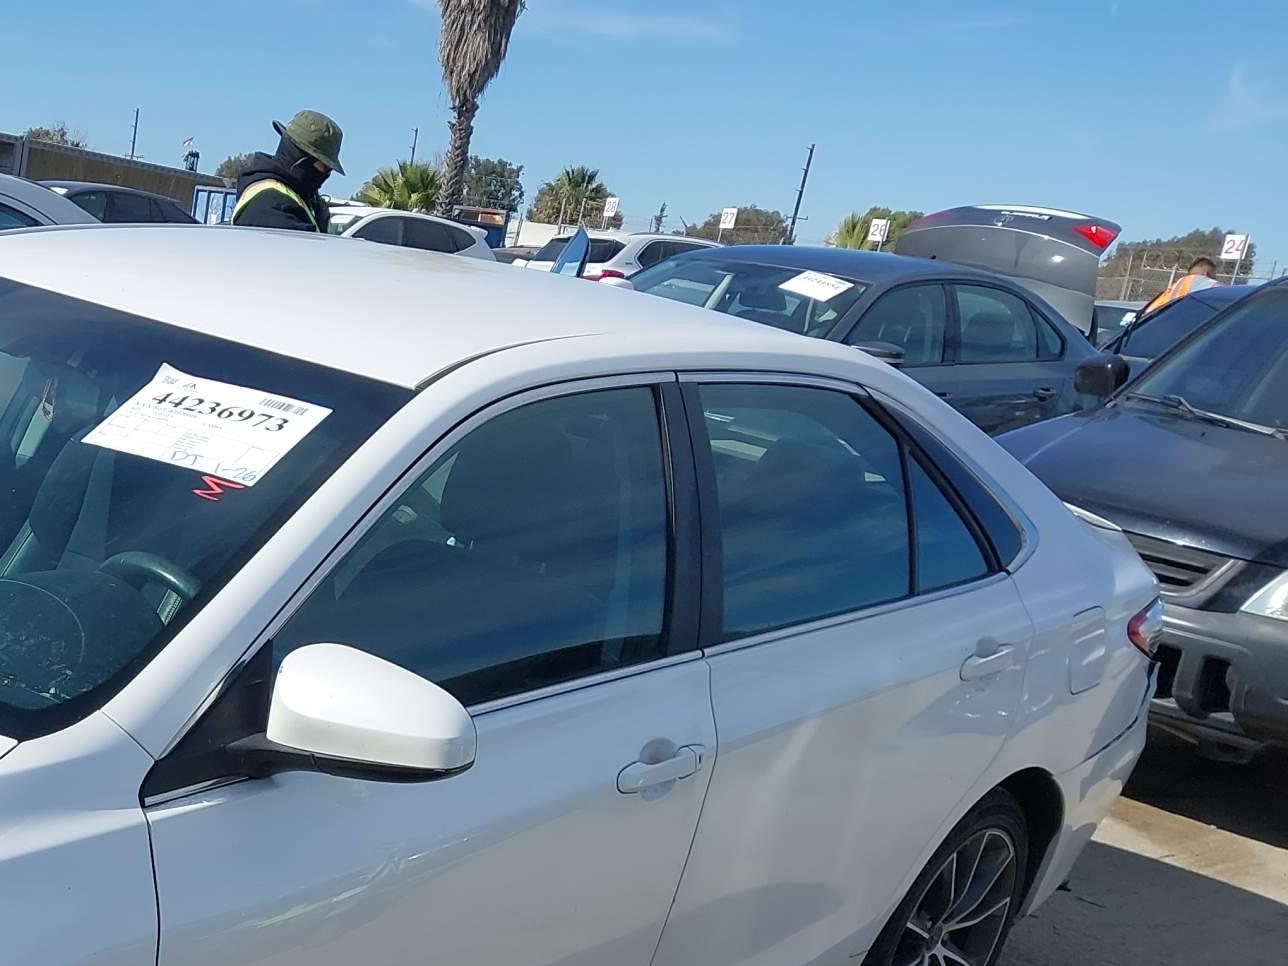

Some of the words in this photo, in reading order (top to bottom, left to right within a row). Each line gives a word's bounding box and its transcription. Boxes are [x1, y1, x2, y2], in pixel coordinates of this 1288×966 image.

[605, 200, 617, 213] 28
[722, 212, 735, 224] 27
[1224, 239, 1245, 254] 24
[152, 391, 289, 433] 44236973
